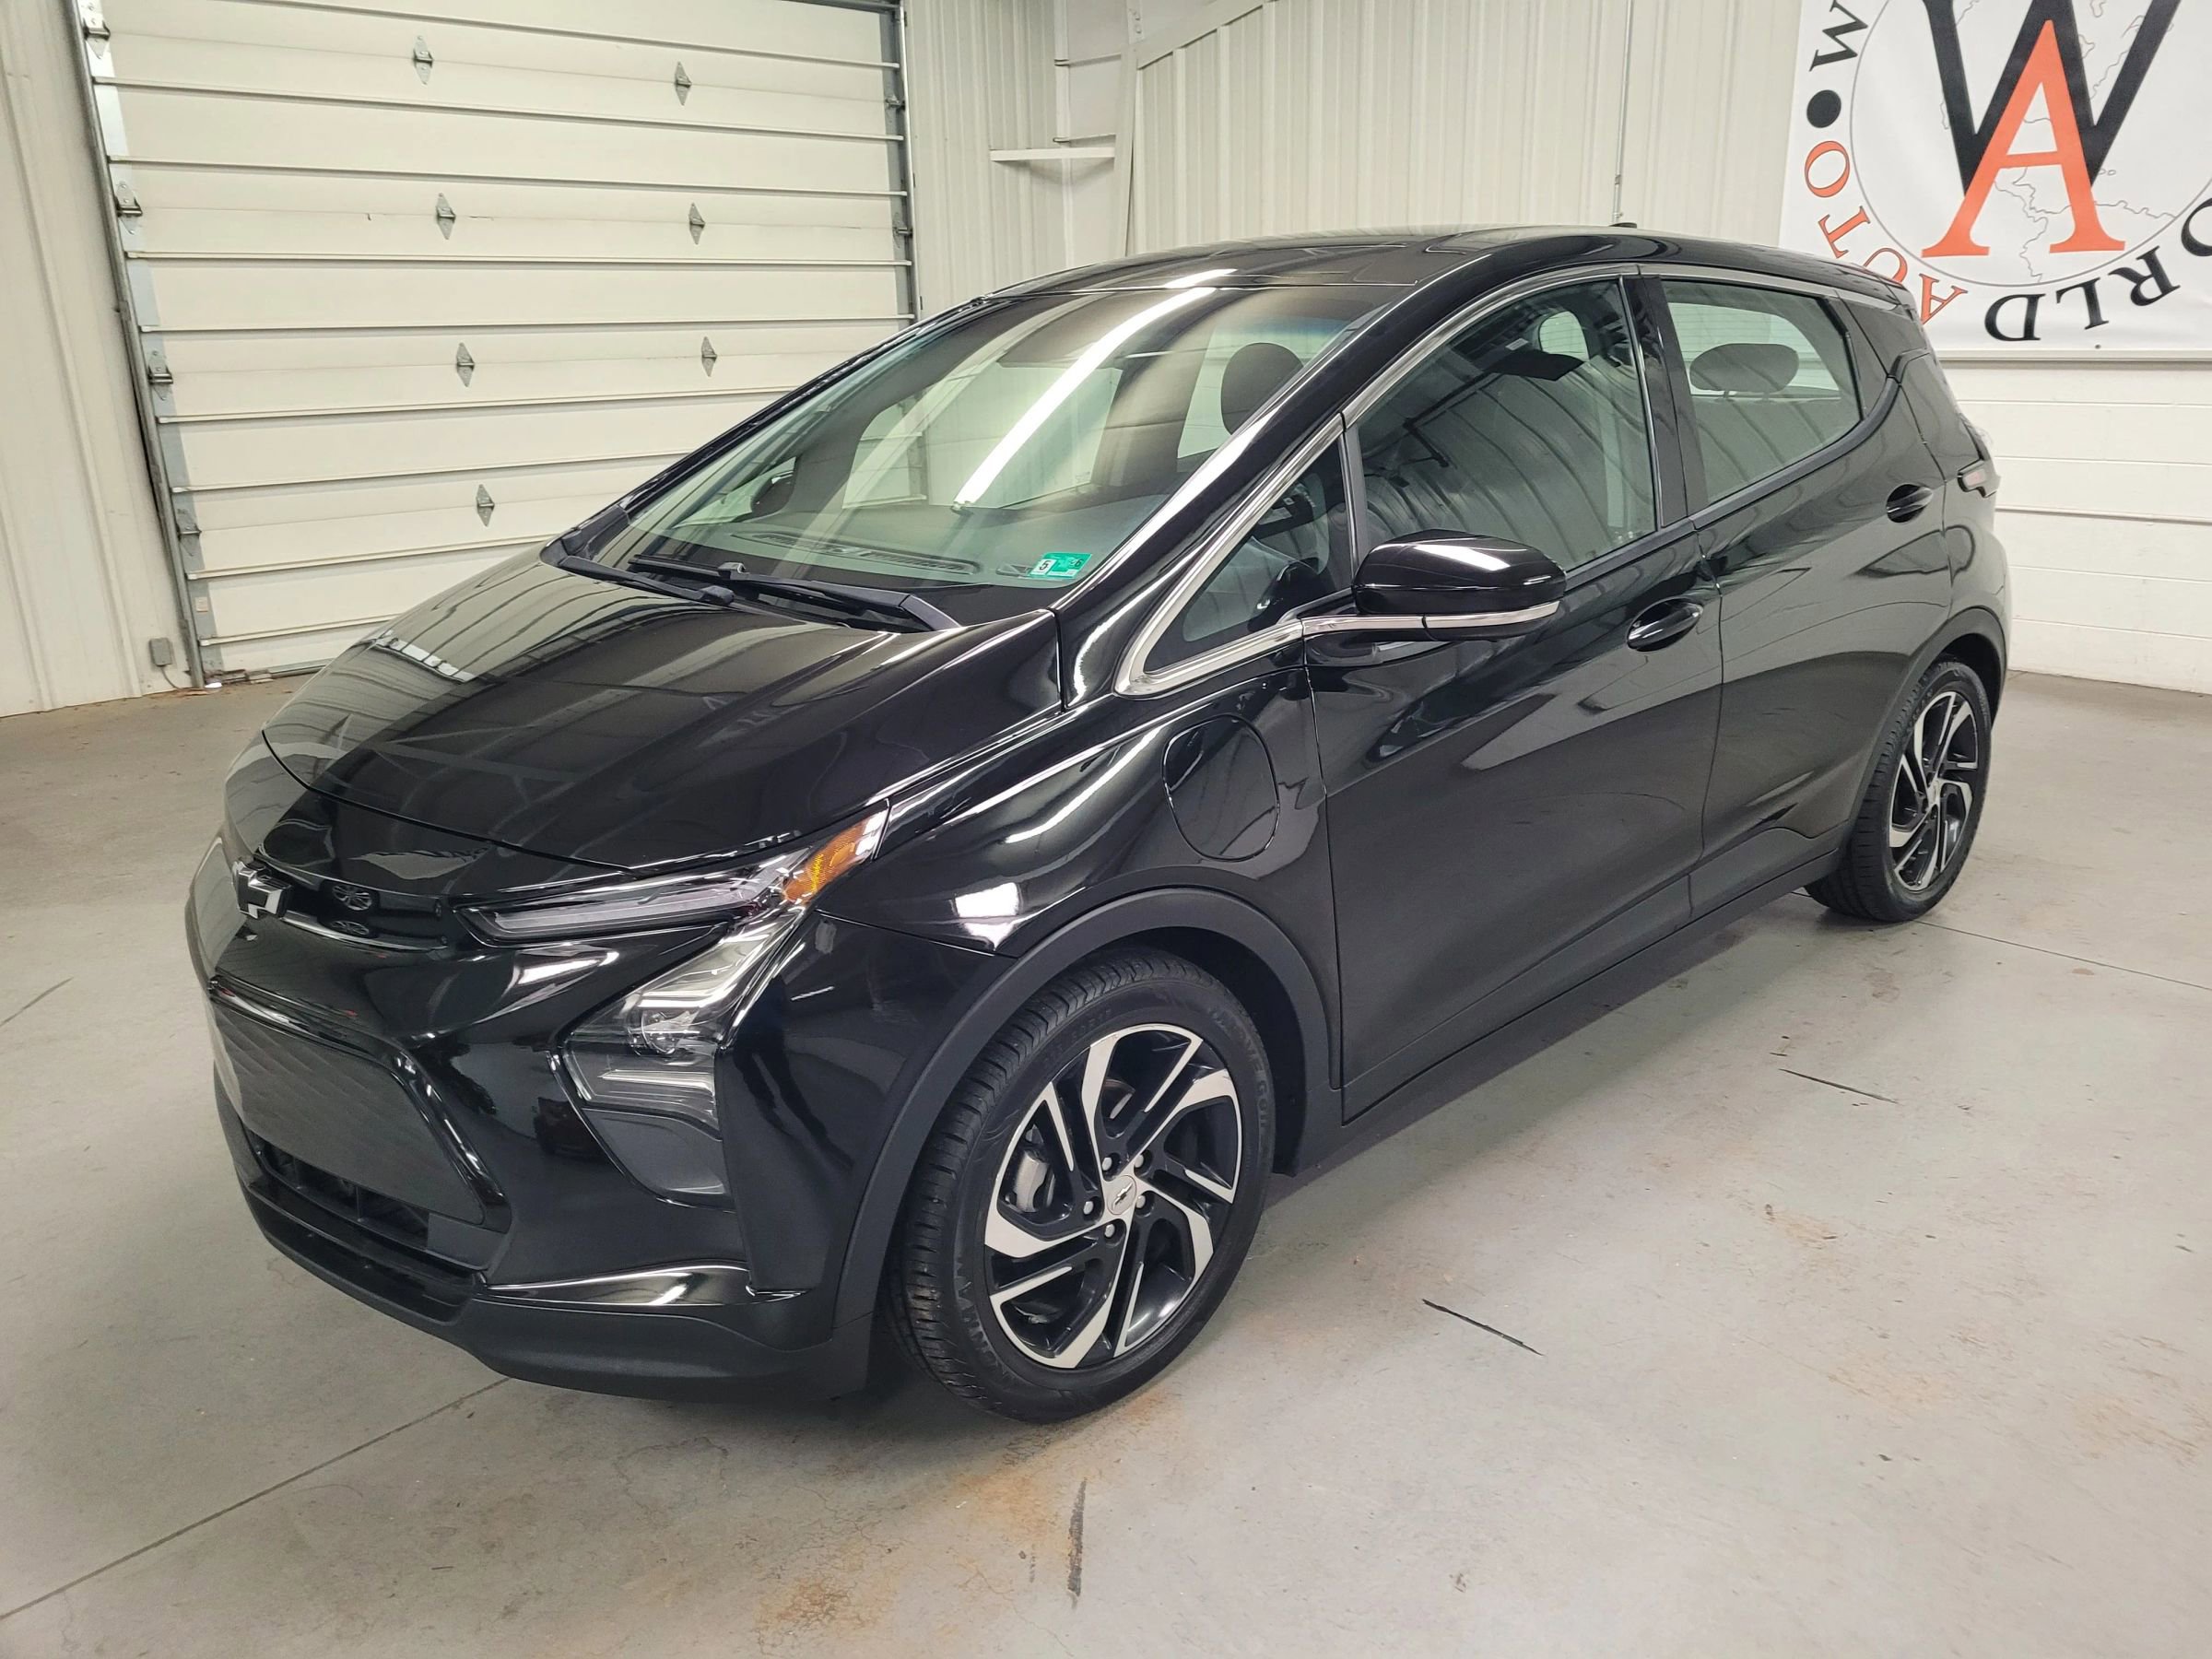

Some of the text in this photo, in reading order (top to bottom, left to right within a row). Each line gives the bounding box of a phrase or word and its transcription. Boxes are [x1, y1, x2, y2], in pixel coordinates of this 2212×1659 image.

[1804, 140, 1969, 325] AUTO
[1984, 195, 2212, 342] ORLD
[1039, 559, 1052, 571] 5
